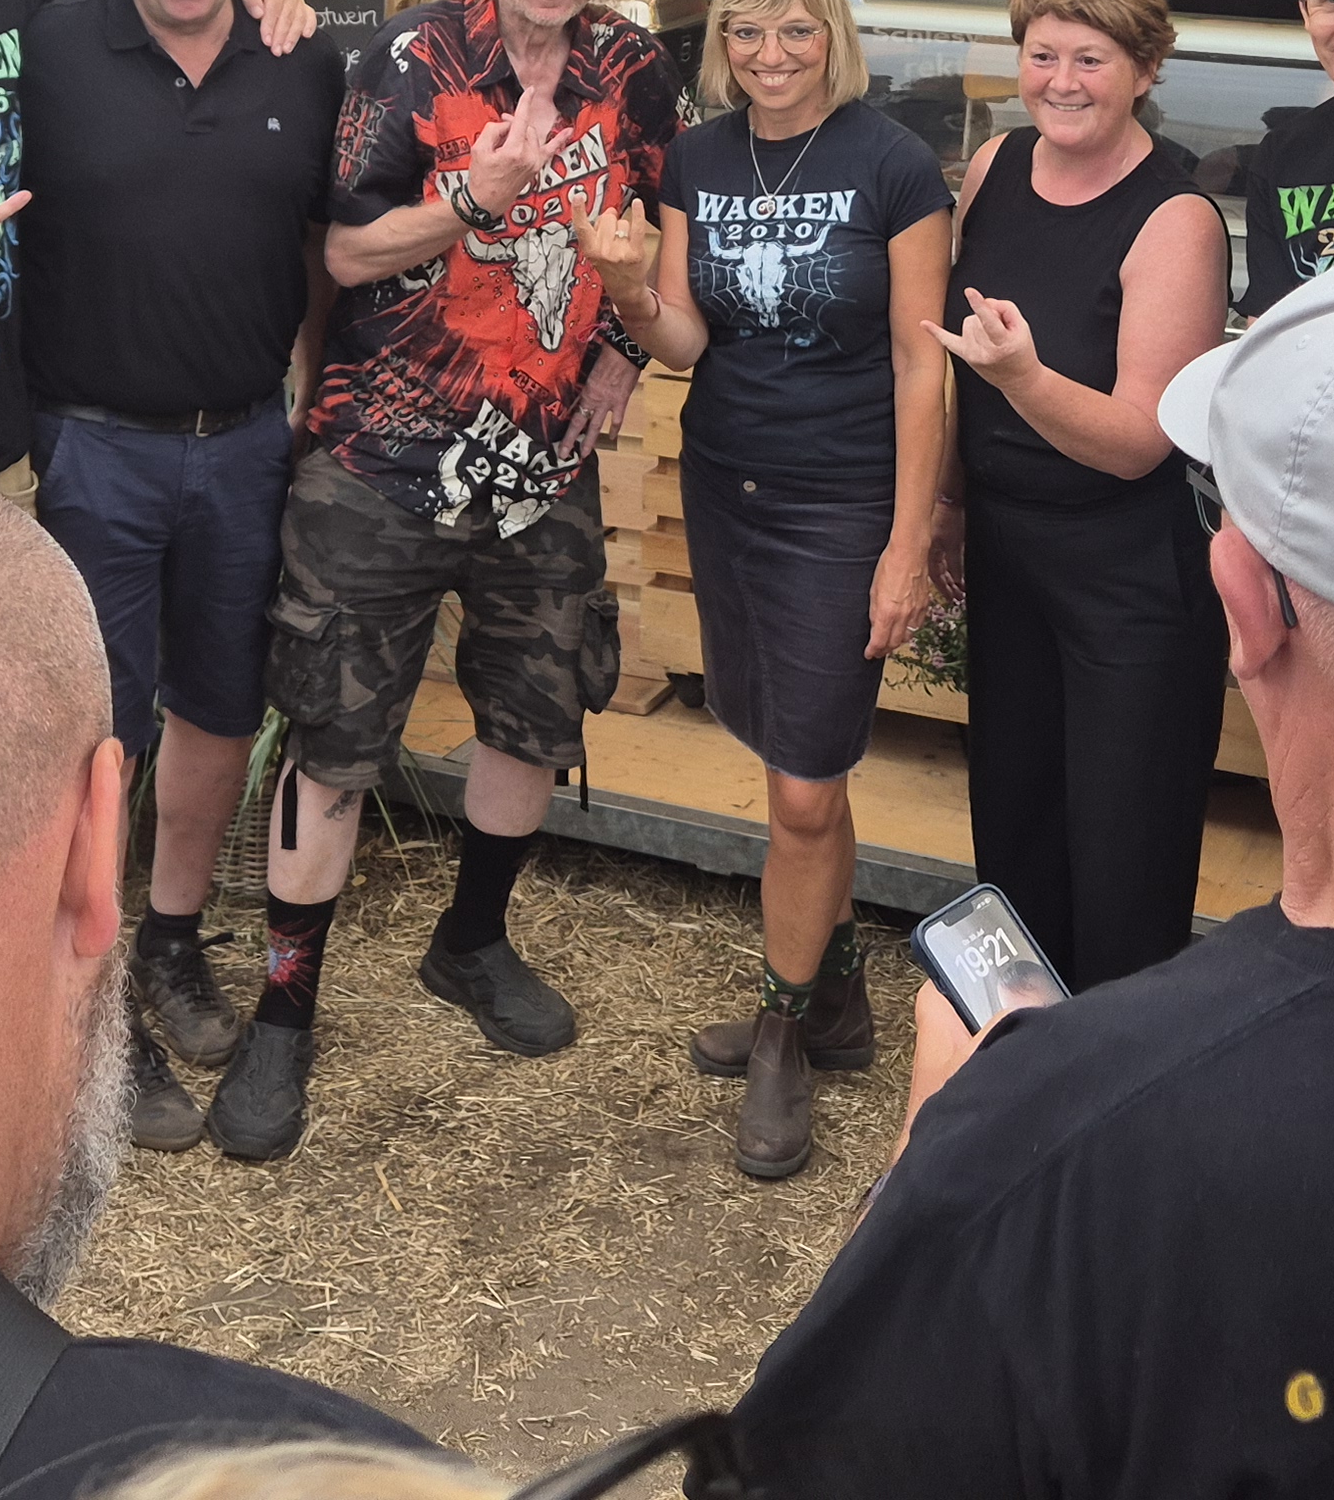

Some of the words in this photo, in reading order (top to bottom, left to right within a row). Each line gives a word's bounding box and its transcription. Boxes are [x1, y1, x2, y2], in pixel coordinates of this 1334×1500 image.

[435, 122, 609, 202] WKEN
[695, 189, 857, 223] WACKEN
[726, 222, 814, 241] 2010
[955, 927, 1018, 983] 19:21
